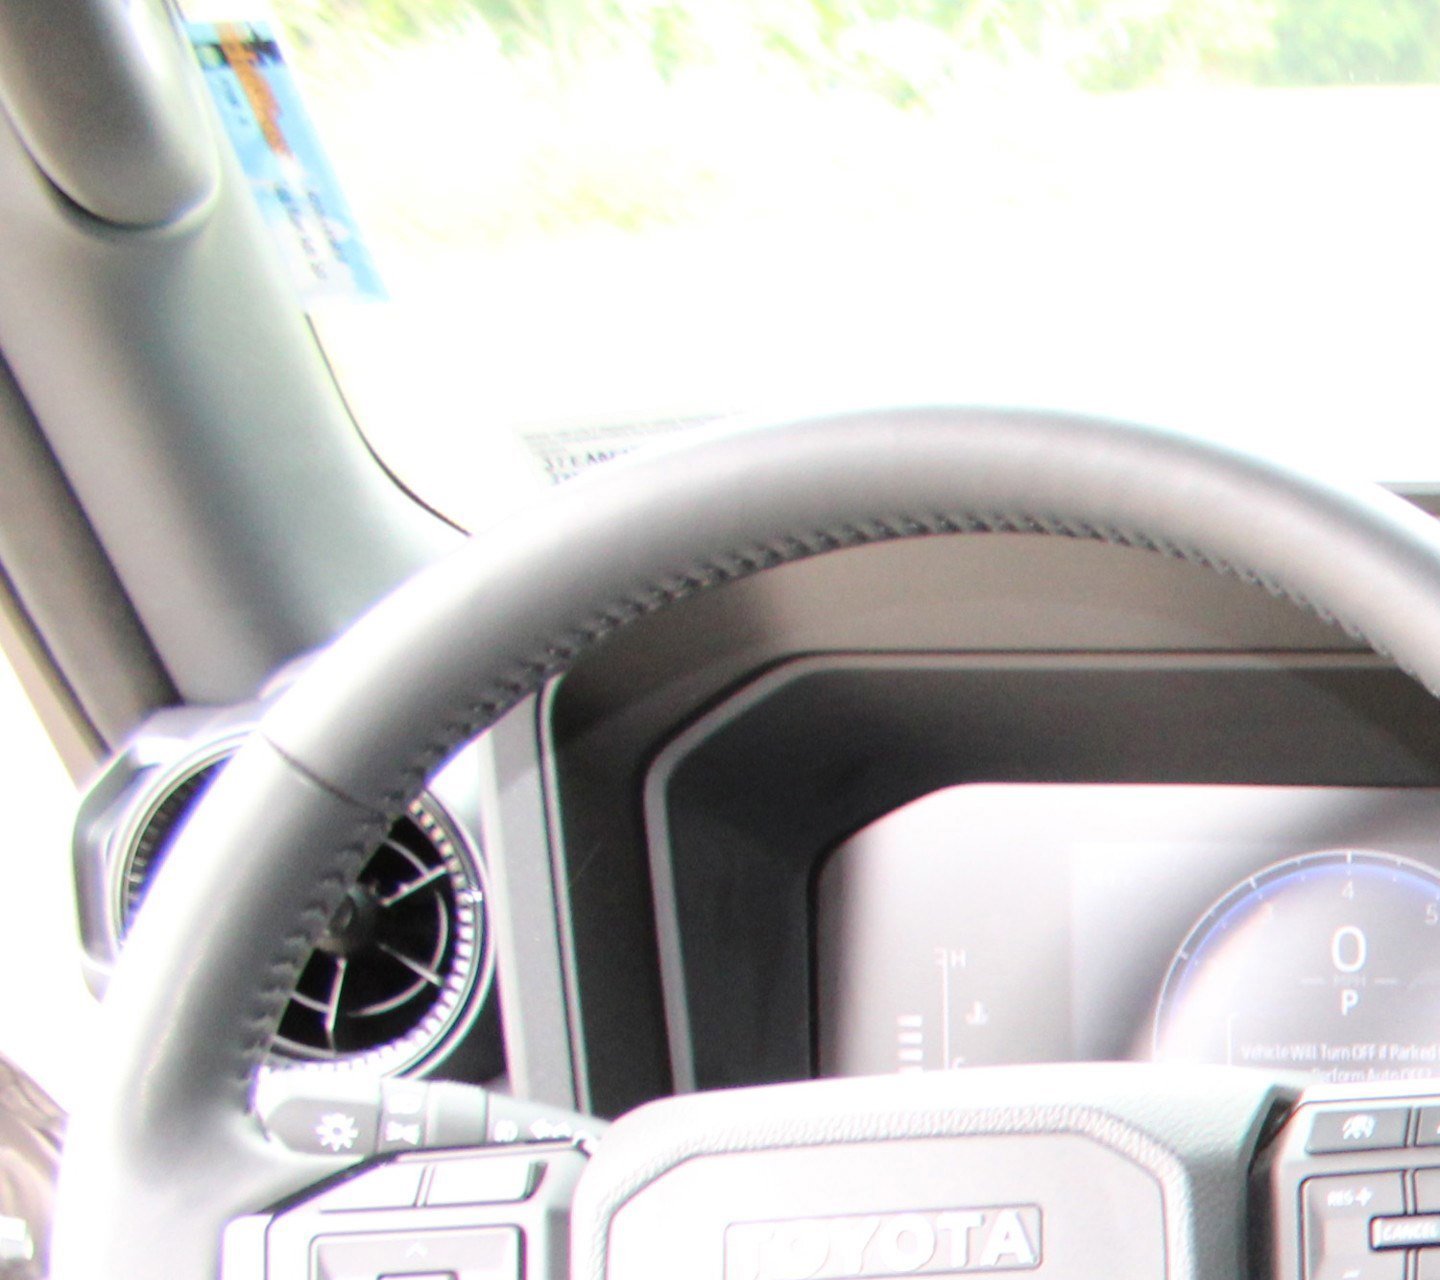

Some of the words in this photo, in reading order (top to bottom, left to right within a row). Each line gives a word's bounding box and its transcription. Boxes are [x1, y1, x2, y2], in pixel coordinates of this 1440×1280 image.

[1340, 881, 1355, 901] 4
[1424, 904, 1439, 926] 5
[1330, 926, 1368, 974] 0
[1341, 989, 1359, 1016] P
